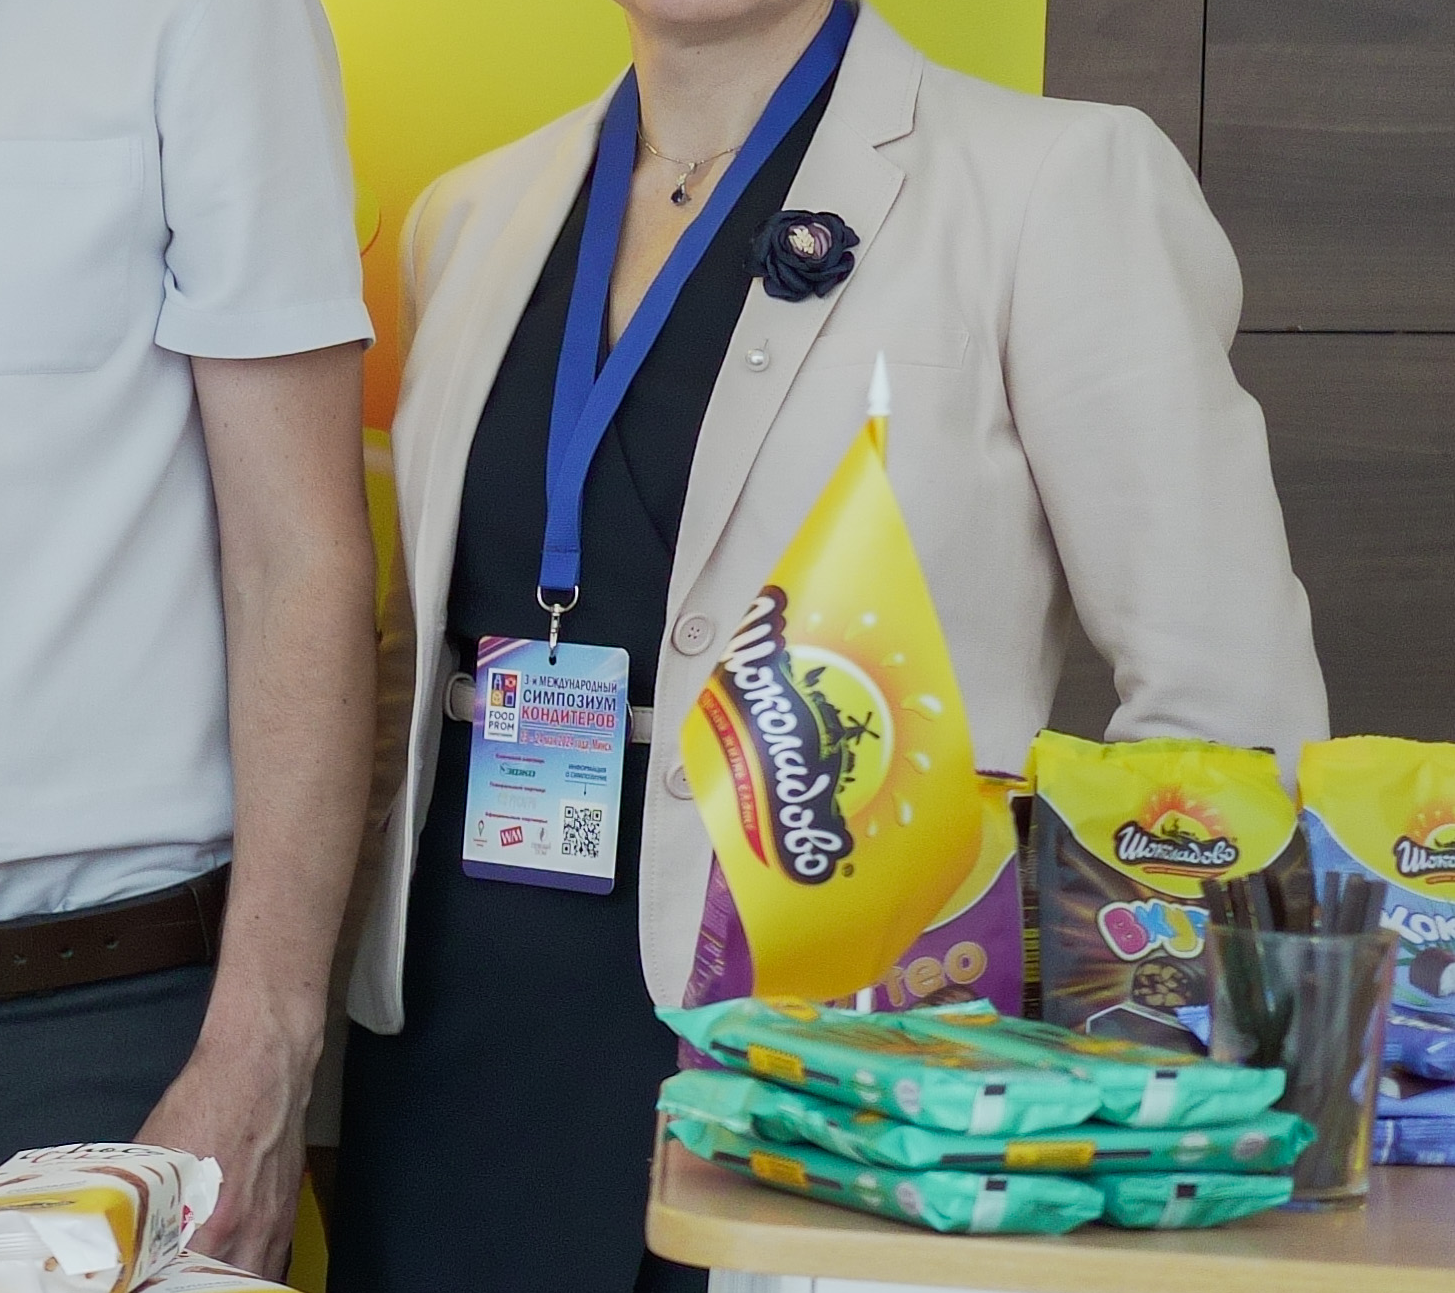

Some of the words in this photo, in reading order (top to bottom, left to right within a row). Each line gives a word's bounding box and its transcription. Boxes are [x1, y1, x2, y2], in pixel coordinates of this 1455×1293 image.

[539, 675, 617, 693] МЕЖДУНАРОДНЫЙ
[523, 689, 616, 711] СИМПОЗИУМ
[489, 721, 514, 731] PROM
[490, 711, 515, 721] FOOD
[521, 706, 615, 728] КОНДИТЕРОВ
[718, 596, 843, 876] Шоколадово
